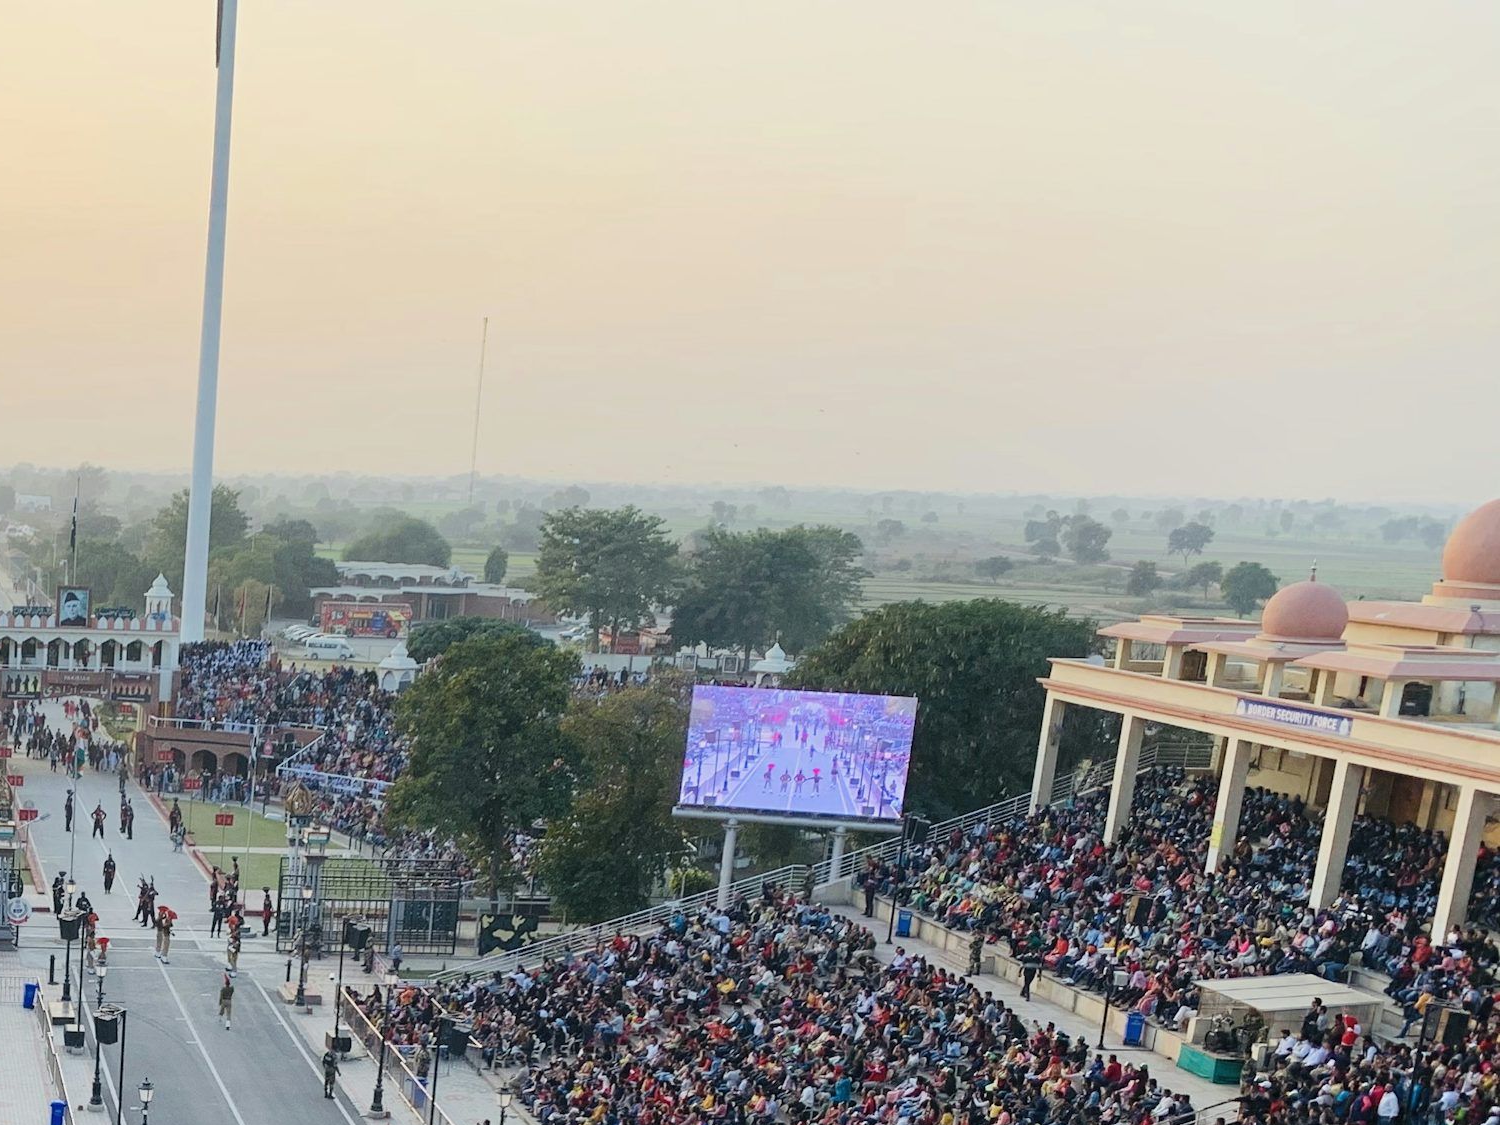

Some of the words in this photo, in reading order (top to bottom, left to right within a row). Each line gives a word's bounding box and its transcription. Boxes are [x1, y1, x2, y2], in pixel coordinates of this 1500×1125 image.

[1248, 704, 1276, 718] BORDER
[1276, 709, 1313, 726] SECURITY
[1312, 715, 1339, 731] FORCE
